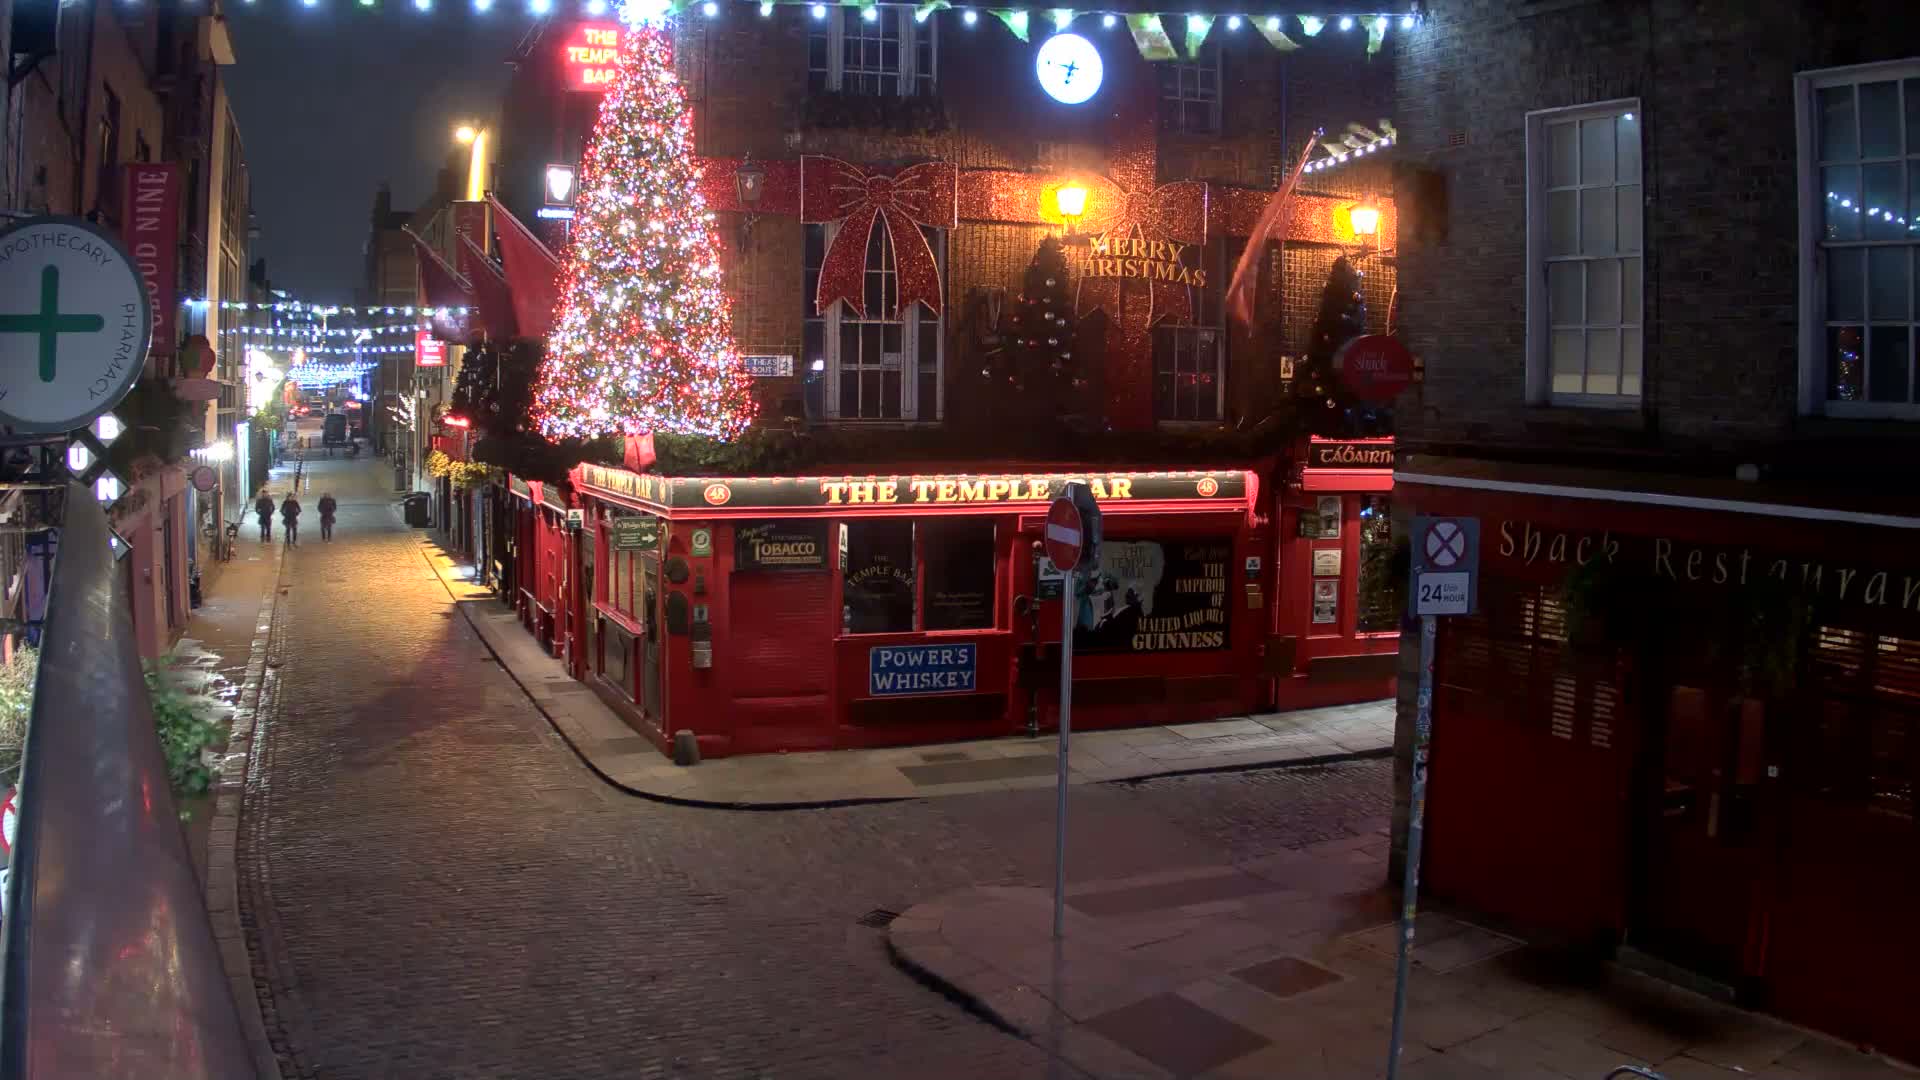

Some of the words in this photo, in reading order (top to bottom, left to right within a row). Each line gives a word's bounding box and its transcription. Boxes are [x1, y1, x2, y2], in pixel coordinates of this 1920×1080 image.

[584, 28, 617, 46] THE
[567, 47, 629, 64] TEMPL
[136, 171, 168, 231] NINE
[1088, 236, 1184, 263] MERRY
[88, 303, 136, 400] PHARMACY
[593, 469, 606, 487] THE
[607, 470, 633, 496] TEMPLE
[635, 477, 652, 500] BAR
[822, 480, 898, 504] THE
[910, 478, 1049, 502] TEMPLE
[1066, 478, 1132, 499] AR
[749, 538, 816, 561] TOBACCO
[1499, 520, 1620, 566] Shack
[848, 565, 890, 587] TEMPLE
[893, 566, 914, 590] BAR
[1204, 563, 1225, 577] THE
[1175, 578, 1225, 592] EMPEROR
[1421, 583, 1442, 602] 24
[1211, 594, 1224, 607] OF
[1443, 592, 1465, 602] HOUR
[1137, 615, 1180, 632] MALTED
[1184, 608, 1224, 628] LIQUORS
[1132, 631, 1225, 650] GUINNESS
[879, 648, 969, 668] POWER'S
[873, 671, 971, 690] WHISKEY
